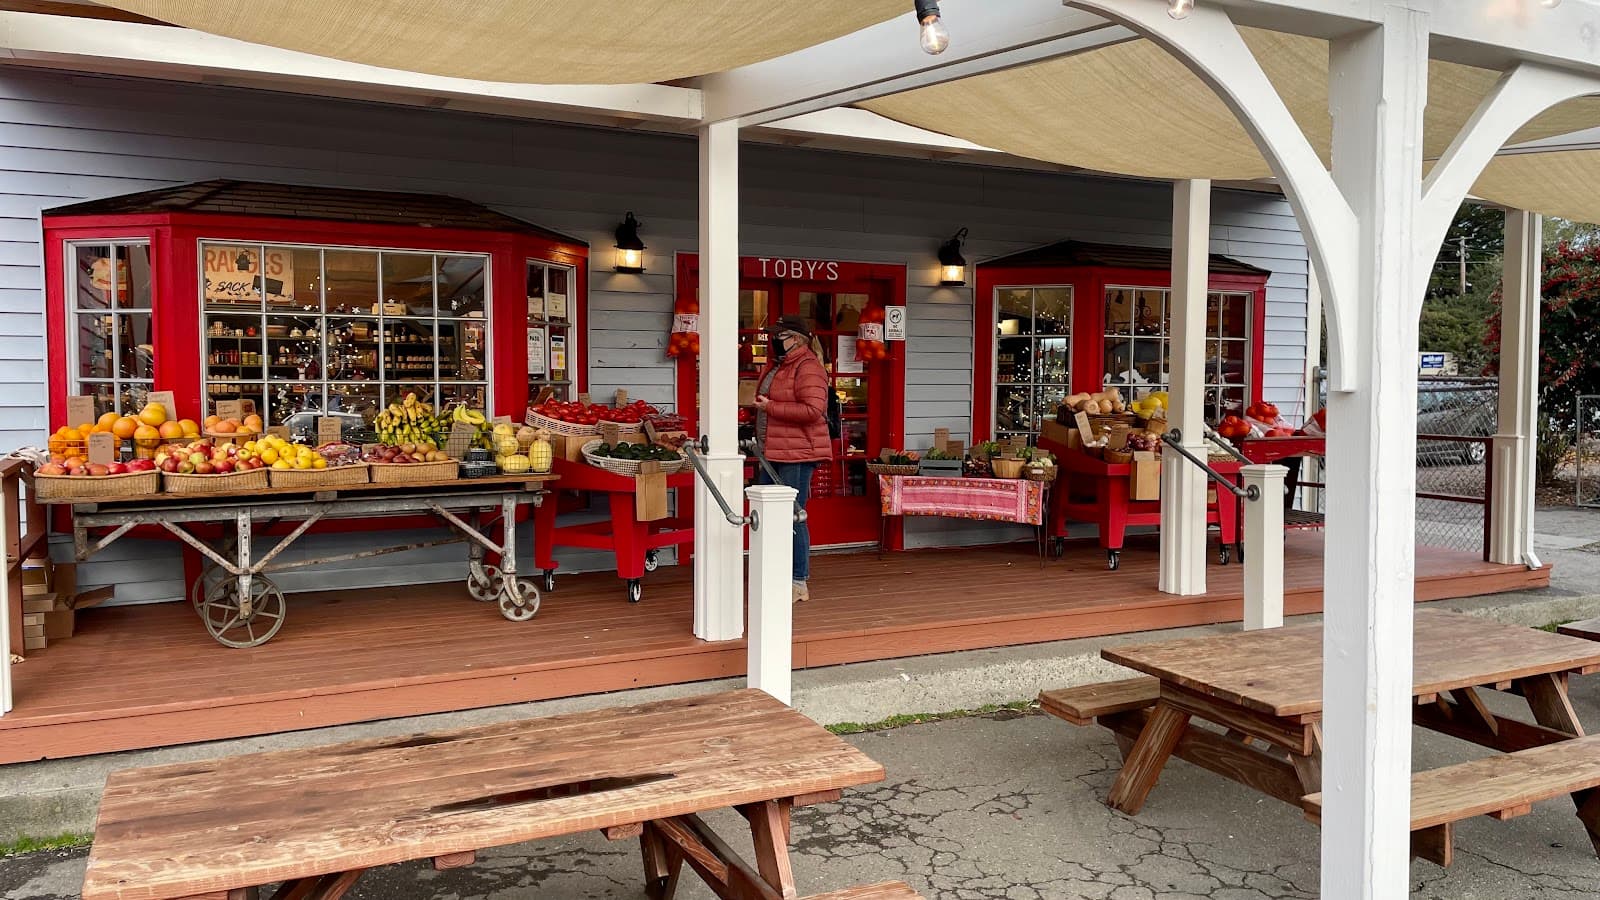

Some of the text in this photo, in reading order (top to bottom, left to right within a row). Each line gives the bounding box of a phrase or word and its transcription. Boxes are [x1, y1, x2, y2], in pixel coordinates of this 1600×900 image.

[205, 250, 283, 275] RAGS
[758, 258, 839, 281] TOBY'S
[215, 281, 251, 292] SACK
